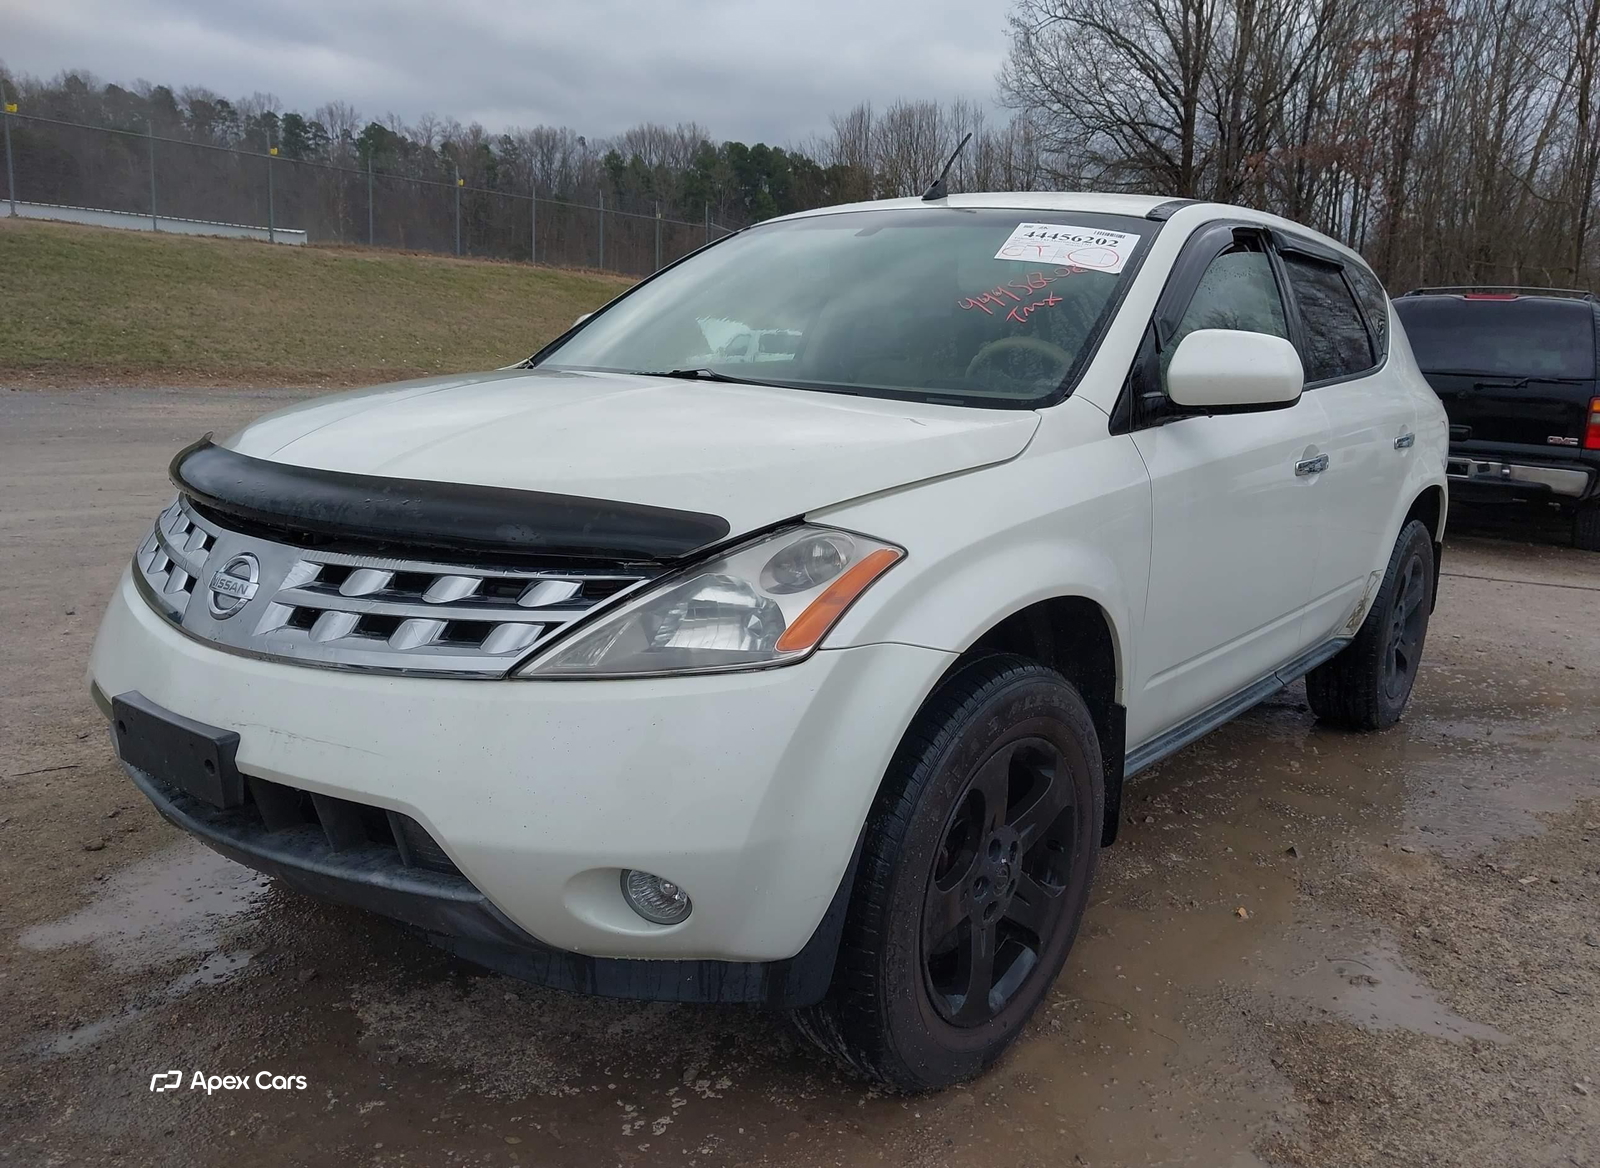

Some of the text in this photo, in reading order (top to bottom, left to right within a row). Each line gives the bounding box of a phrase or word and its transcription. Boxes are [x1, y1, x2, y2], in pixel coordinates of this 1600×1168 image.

[1023, 231, 1119, 248] 44456202
[1547, 436, 1578, 445] GMC
[212, 576, 248, 595] NISSAN
